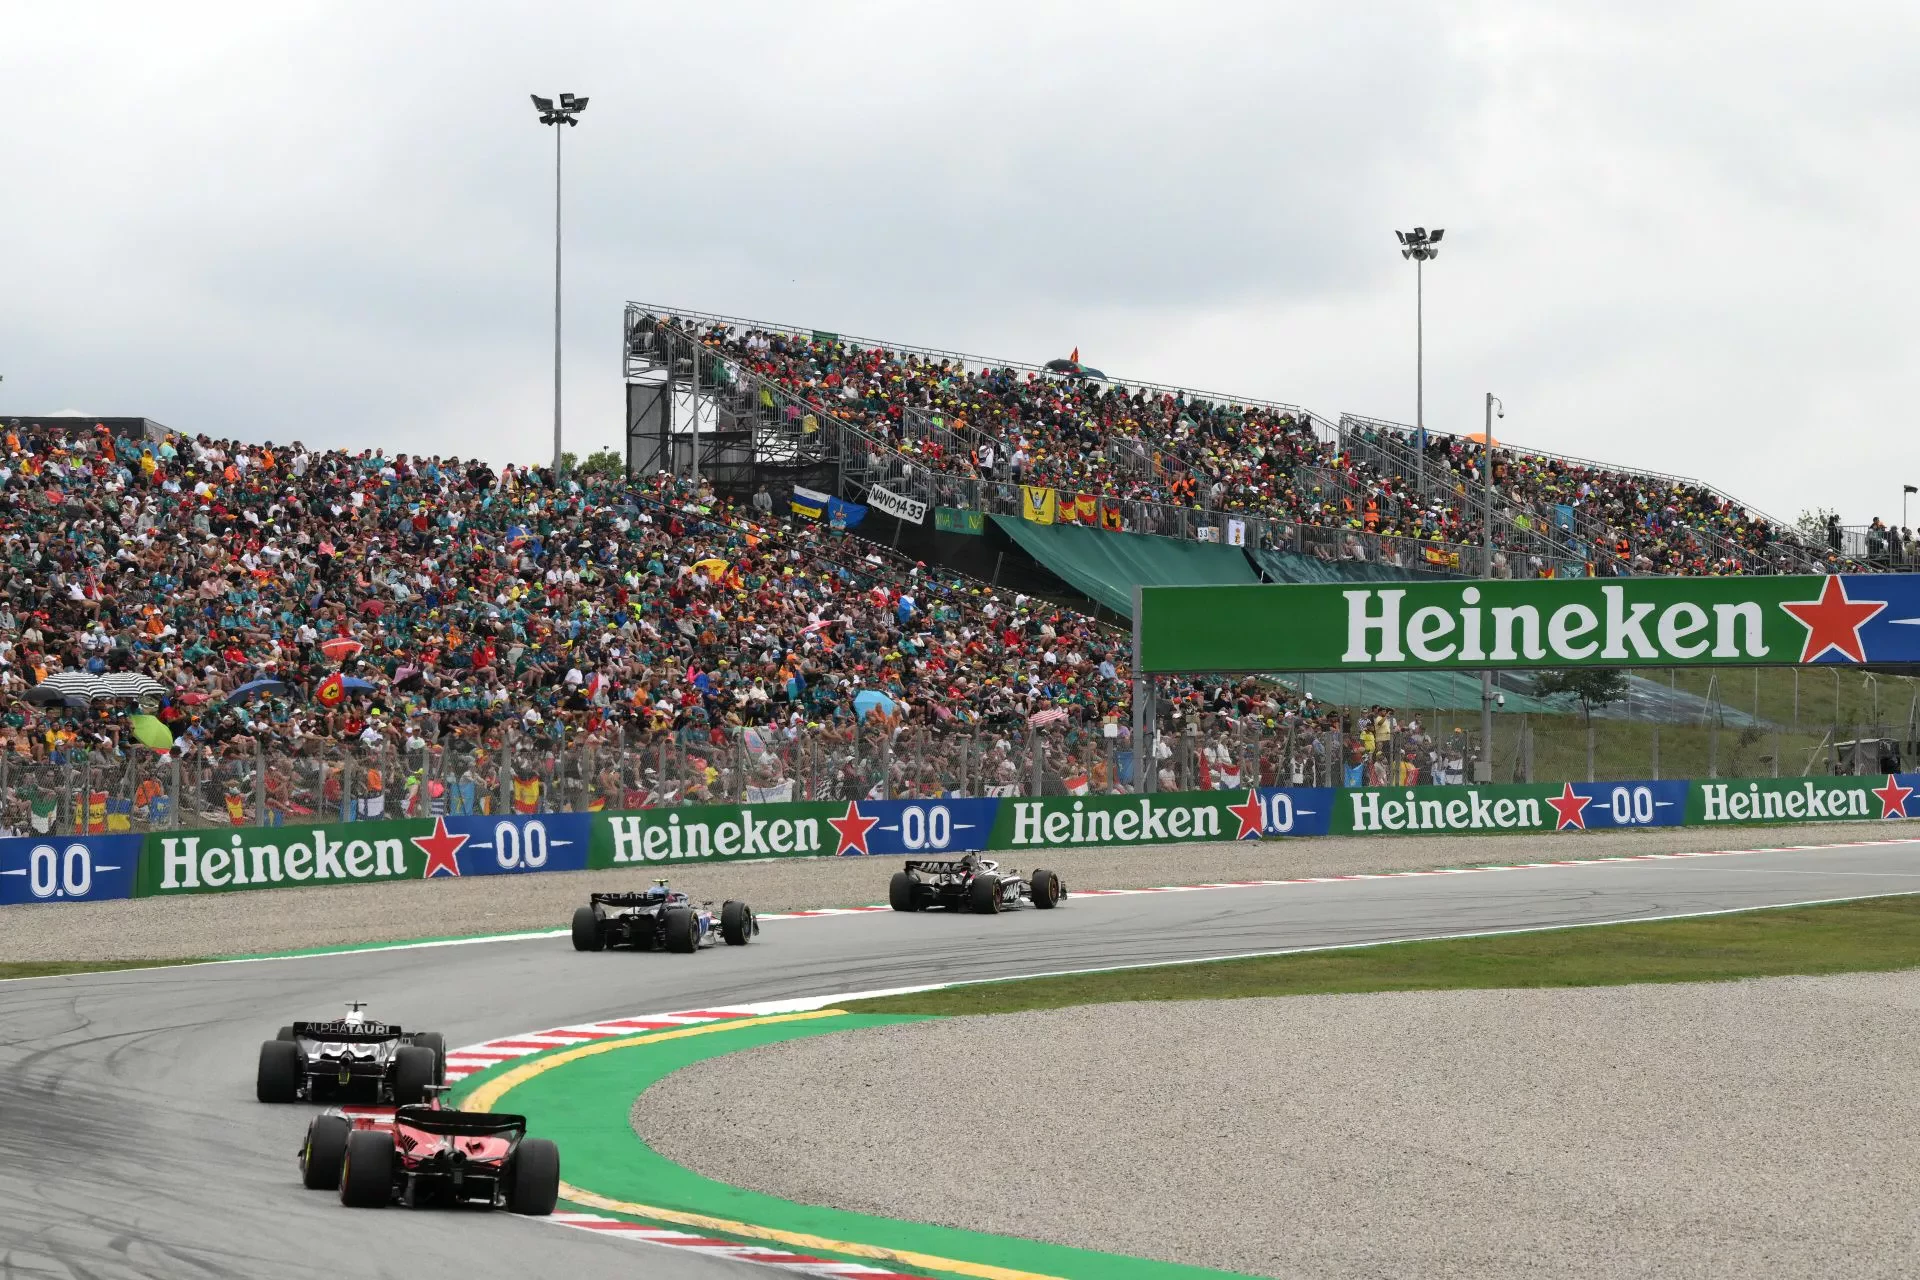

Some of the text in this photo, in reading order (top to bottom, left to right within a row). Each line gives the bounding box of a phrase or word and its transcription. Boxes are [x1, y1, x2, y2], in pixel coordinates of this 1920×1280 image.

[1341, 585, 1770, 662] Heineken
[1011, 799, 1221, 844] Heineken
[1349, 785, 1654, 831] Heineken 0.0
[1701, 782, 1870, 821] Heineken
[160, 820, 548, 889] Heineken 0.0
[607, 805, 951, 862] Heineken 0.0
[29, 843, 92, 898] 0.0
